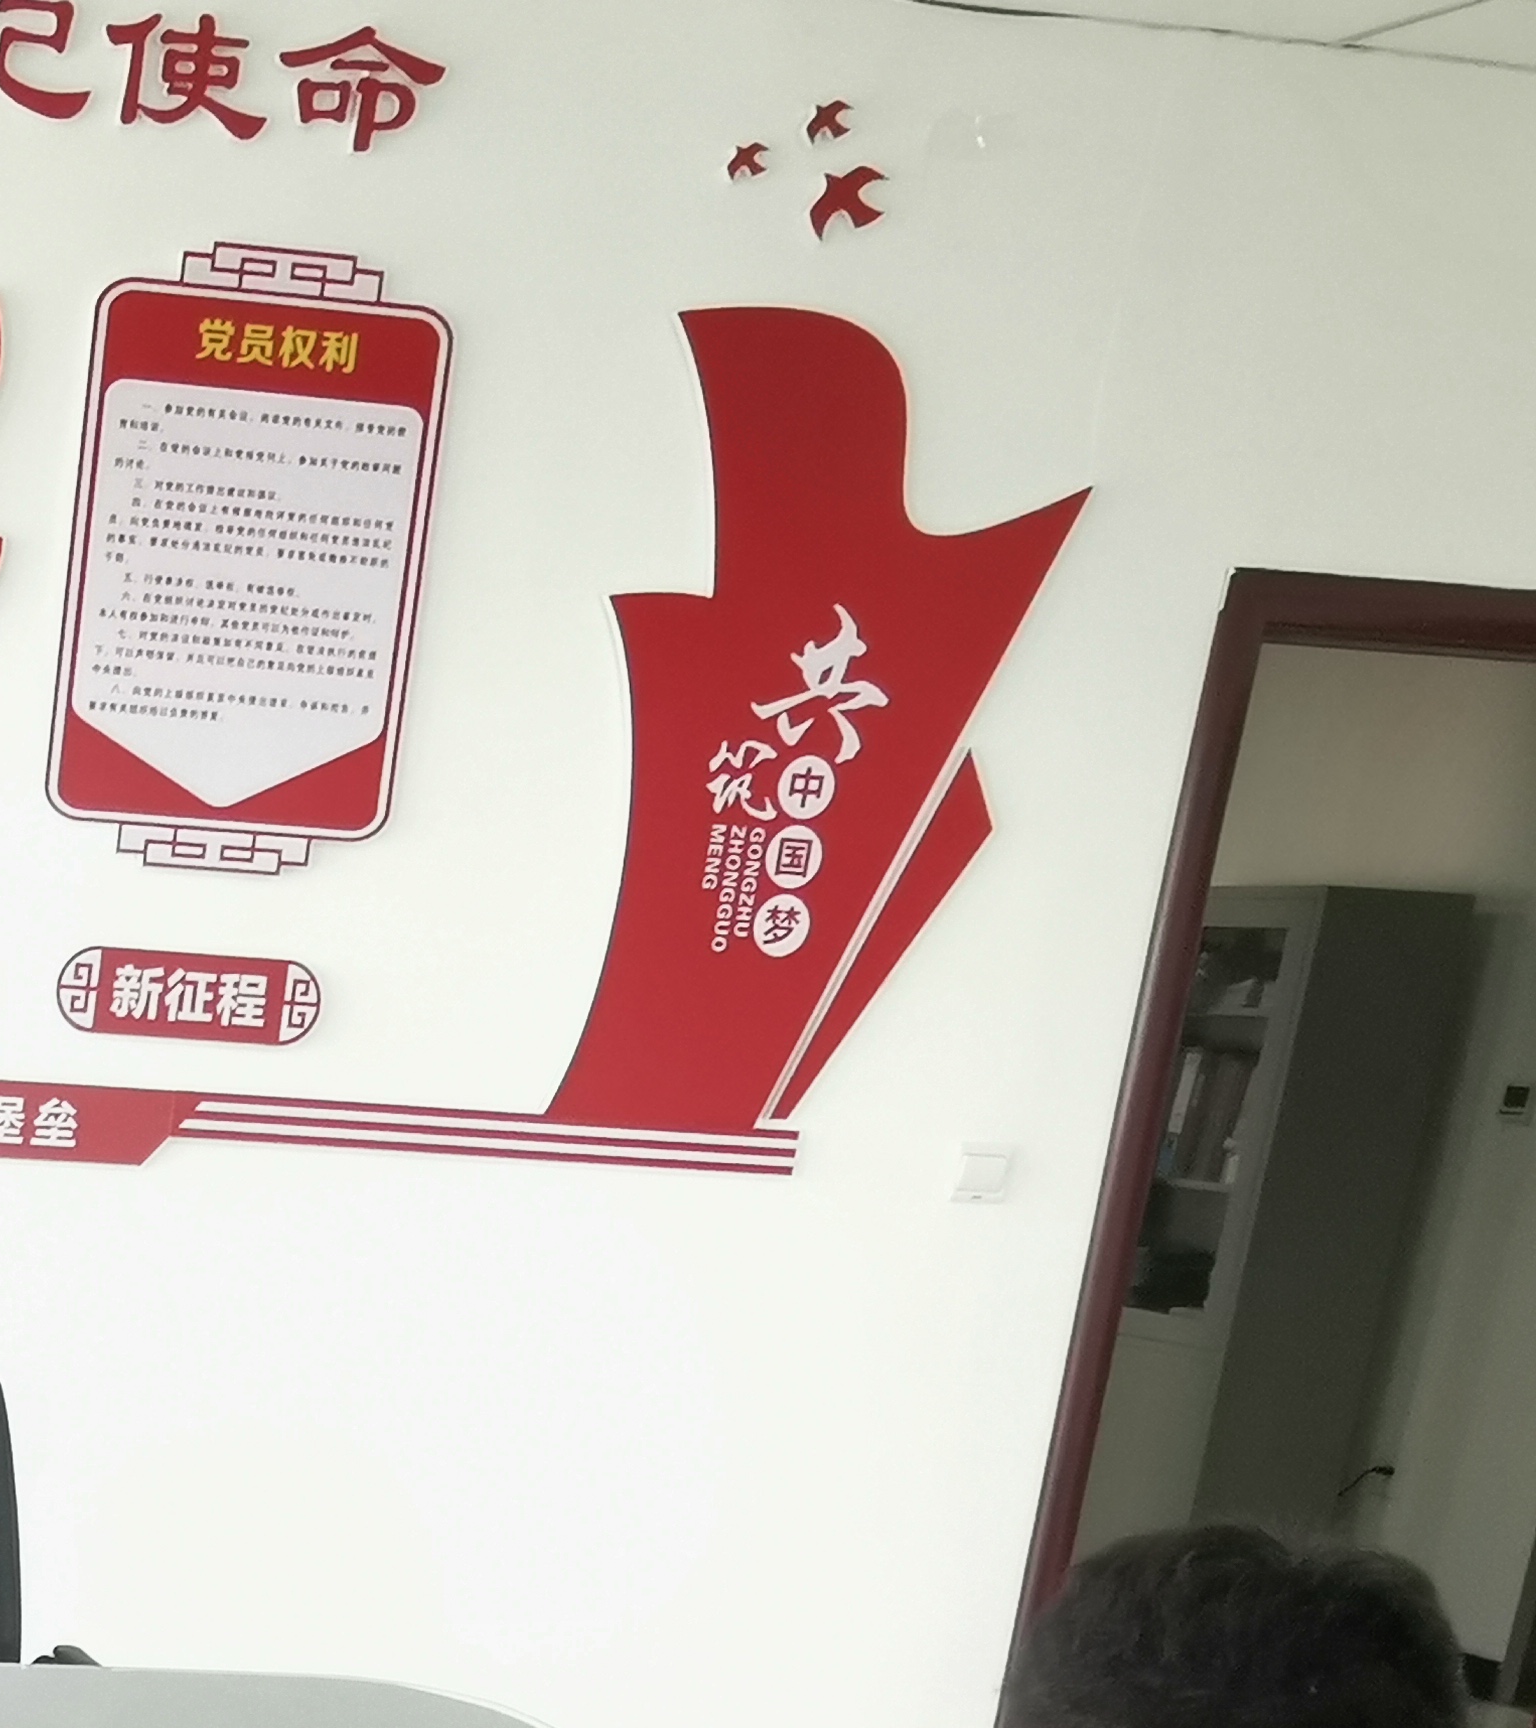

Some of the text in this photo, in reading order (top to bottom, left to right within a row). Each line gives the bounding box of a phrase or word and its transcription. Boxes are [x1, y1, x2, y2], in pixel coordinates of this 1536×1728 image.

[195, 318, 360, 372] 党员权利
[702, 823, 728, 890] MENG
[711, 824, 748, 953] ZHONGGUO
[733, 827, 767, 938] GONGZHU
[760, 763, 827, 948] 中国梦
[108, 963, 269, 1029] 新征程
